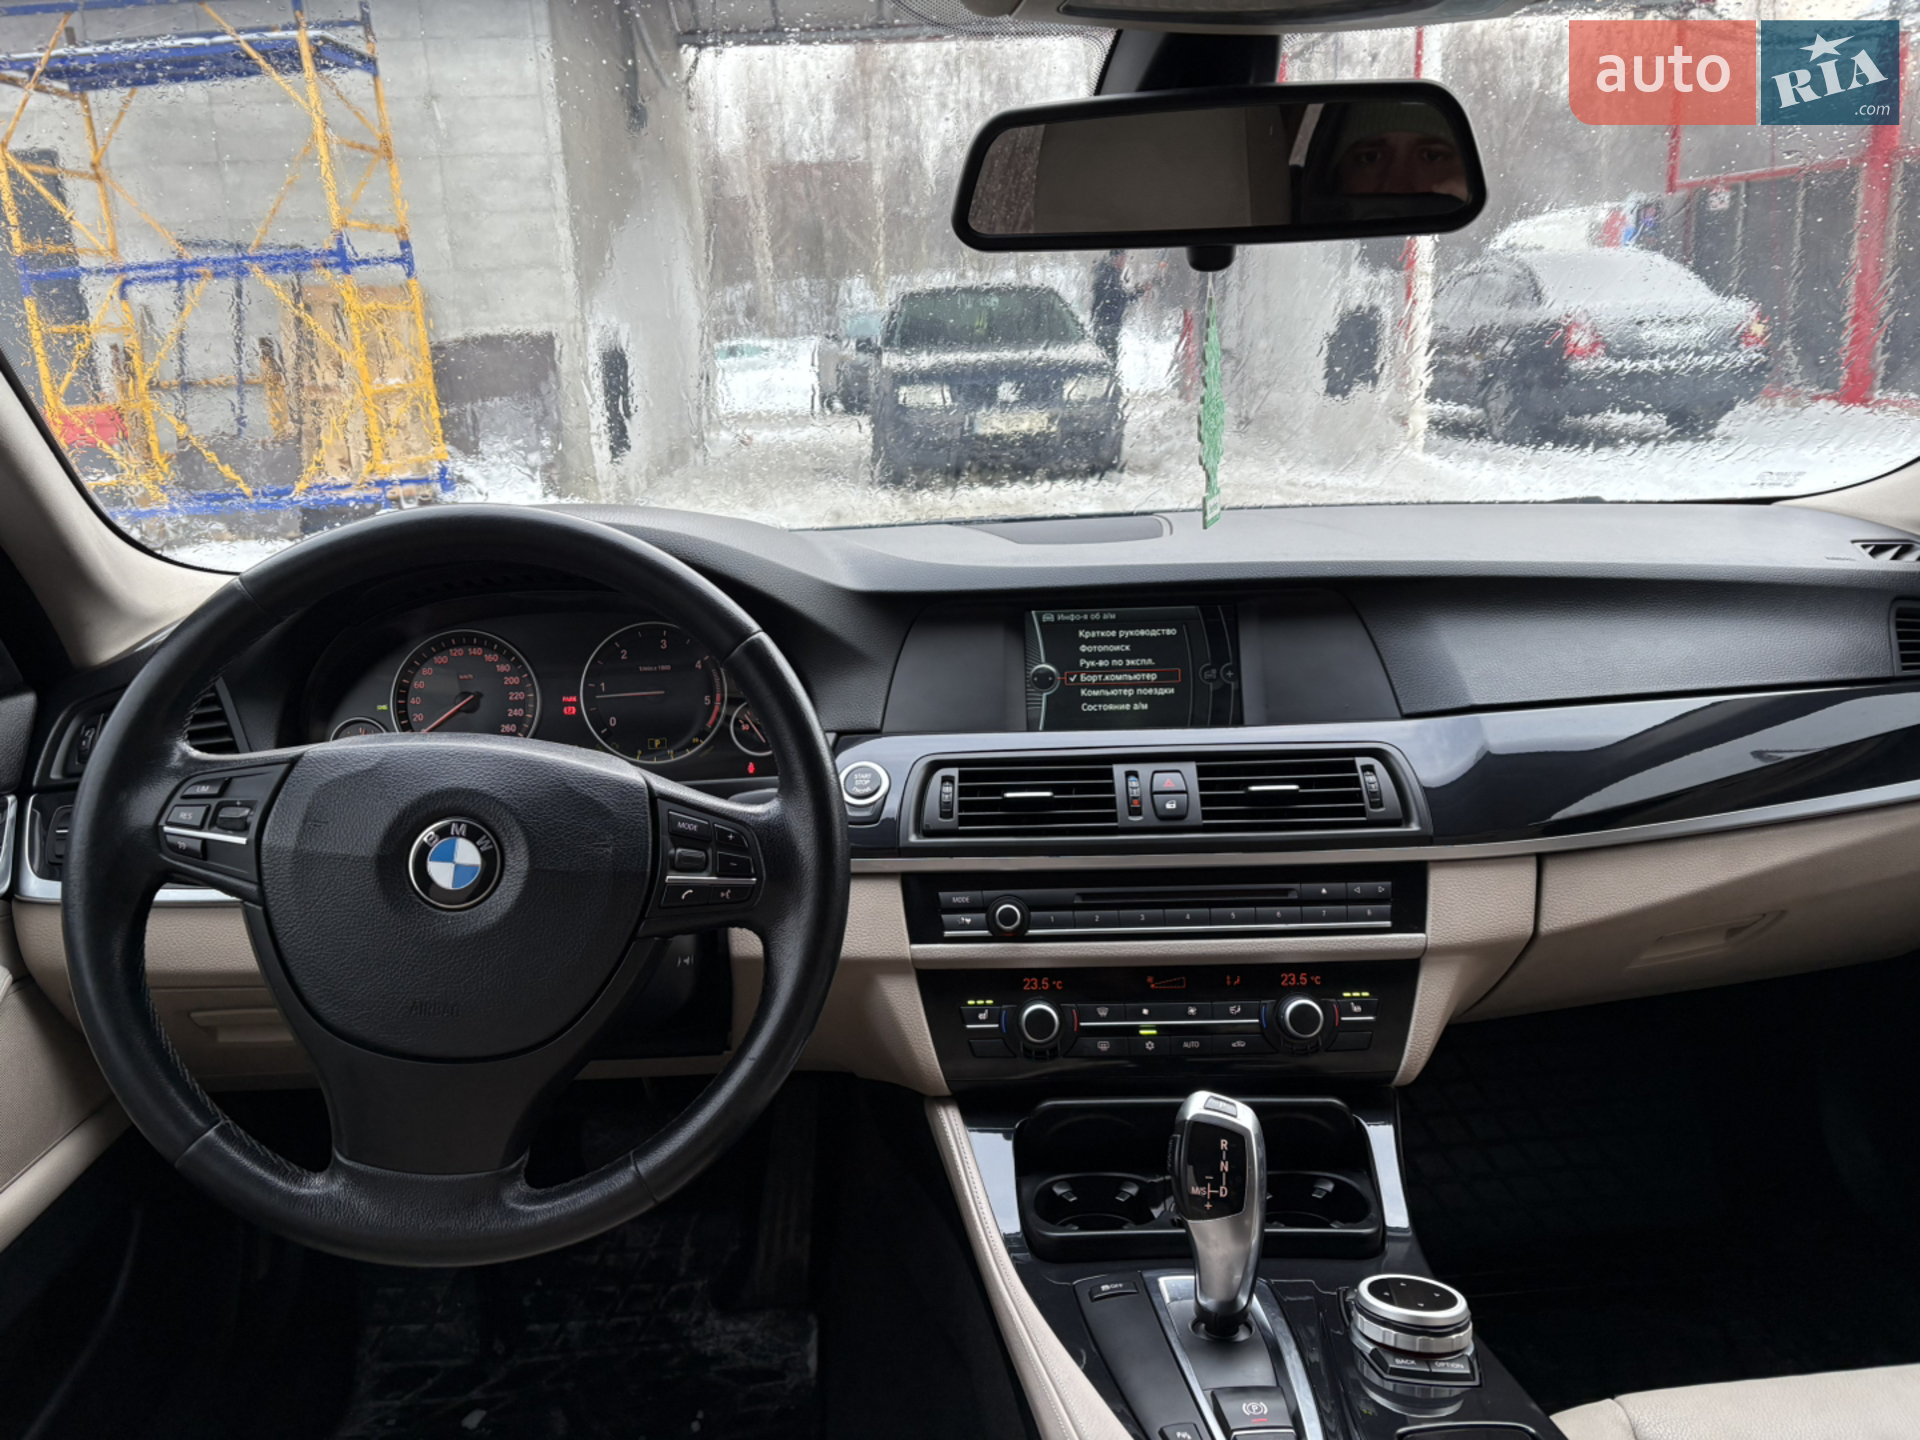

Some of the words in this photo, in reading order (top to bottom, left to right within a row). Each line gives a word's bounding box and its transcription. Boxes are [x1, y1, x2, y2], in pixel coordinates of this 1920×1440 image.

[1057, 612, 1088, 622] Инфо-я
[1090, 612, 1100, 621] об
[1103, 612, 1116, 620] а/м
[1078, 629, 1117, 639] Краткое
[1119, 627, 1177, 638] руководство
[660, 639, 667, 649] 3
[1079, 643, 1131, 653] Фотопоиск
[449, 648, 464, 657] 120
[468, 647, 483, 656] 140
[620, 649, 627, 660] 2
[433, 655, 448, 664] 100
[484, 654, 499, 663] 160
[1079, 658, 1110, 668] Рук-во
[1112, 659, 1124, 667] по
[1125, 658, 1155, 667] экспл.
[496, 663, 511, 672] 180
[695, 659, 702, 670] 4
[421, 667, 433, 676] 80
[503, 676, 520, 685] 200
[1079, 672, 1157, 683] Борт.компьютер
[413, 681, 425, 689] 60
[600, 682, 605, 692] 1
[508, 691, 525, 700] 220
[1080, 687, 1135, 697] Компьютер
[1137, 686, 1175, 696] поездки
[410, 696, 422, 705] 40
[704, 695, 711, 705] 5
[1081, 702, 1131, 711] Состояние
[1133, 701, 1148, 711] а/м
[412, 713, 424, 722] 20
[507, 708, 524, 717] 240
[609, 716, 617, 726] 0
[500, 724, 517, 733] 260
[179, 811, 193, 820] RES
[677, 821, 699, 831] MODE
[423, 822, 494, 852] BMW
[952, 896, 970, 904] MODE
[1023, 978, 1049, 990] 23.5
[1052, 980, 1063, 989] °C
[1281, 973, 1307, 985] 23.5
[1310, 975, 1321, 985] °C
[1183, 1041, 1200, 1049] AUTO
[1220, 1139, 1228, 1150] R
[1220, 1161, 1229, 1172] N
[1191, 1186, 1207, 1195] M/S
[1219, 1186, 1228, 1197] D
[1395, 1358, 1416, 1366] BACK
[1434, 1361, 1465, 1369] OPTION
